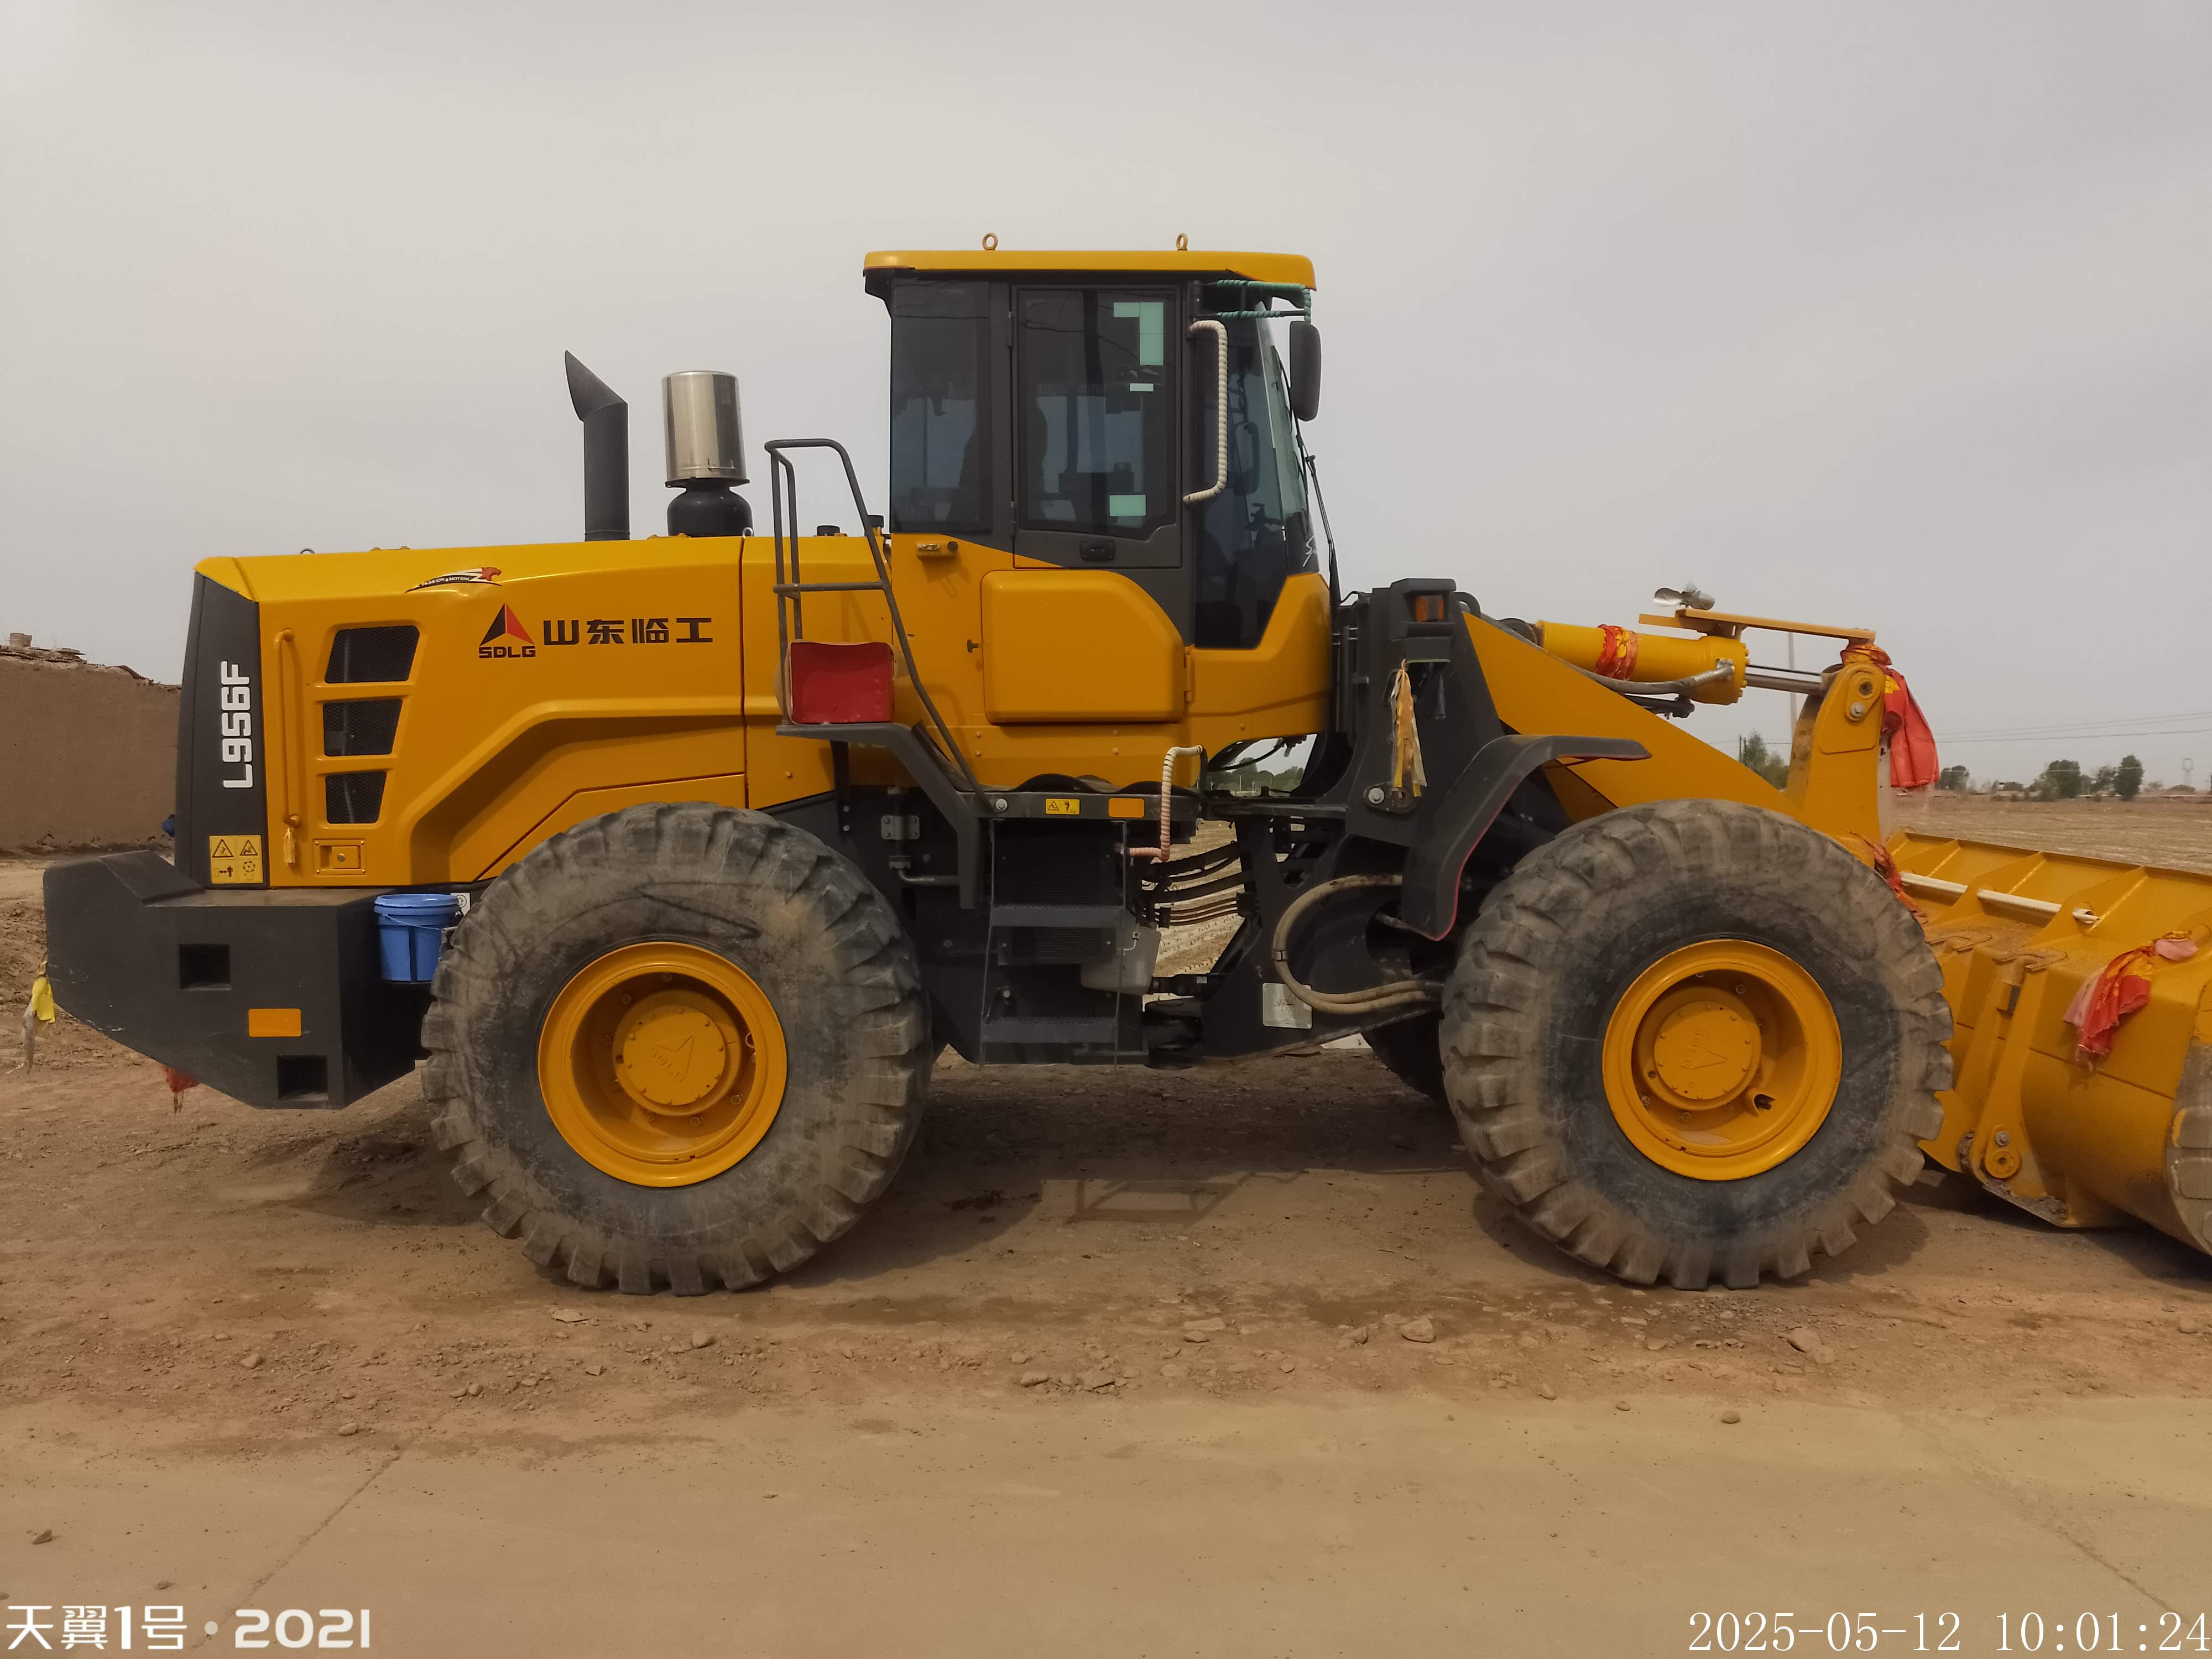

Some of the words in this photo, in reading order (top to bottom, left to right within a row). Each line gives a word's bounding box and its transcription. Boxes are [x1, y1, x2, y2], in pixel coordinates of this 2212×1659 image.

[421, 577, 445, 587] PASSION
[544, 618, 712, 645] 山东临工
[479, 645, 535, 658] SDLG
[221, 661, 253, 787] L956F
